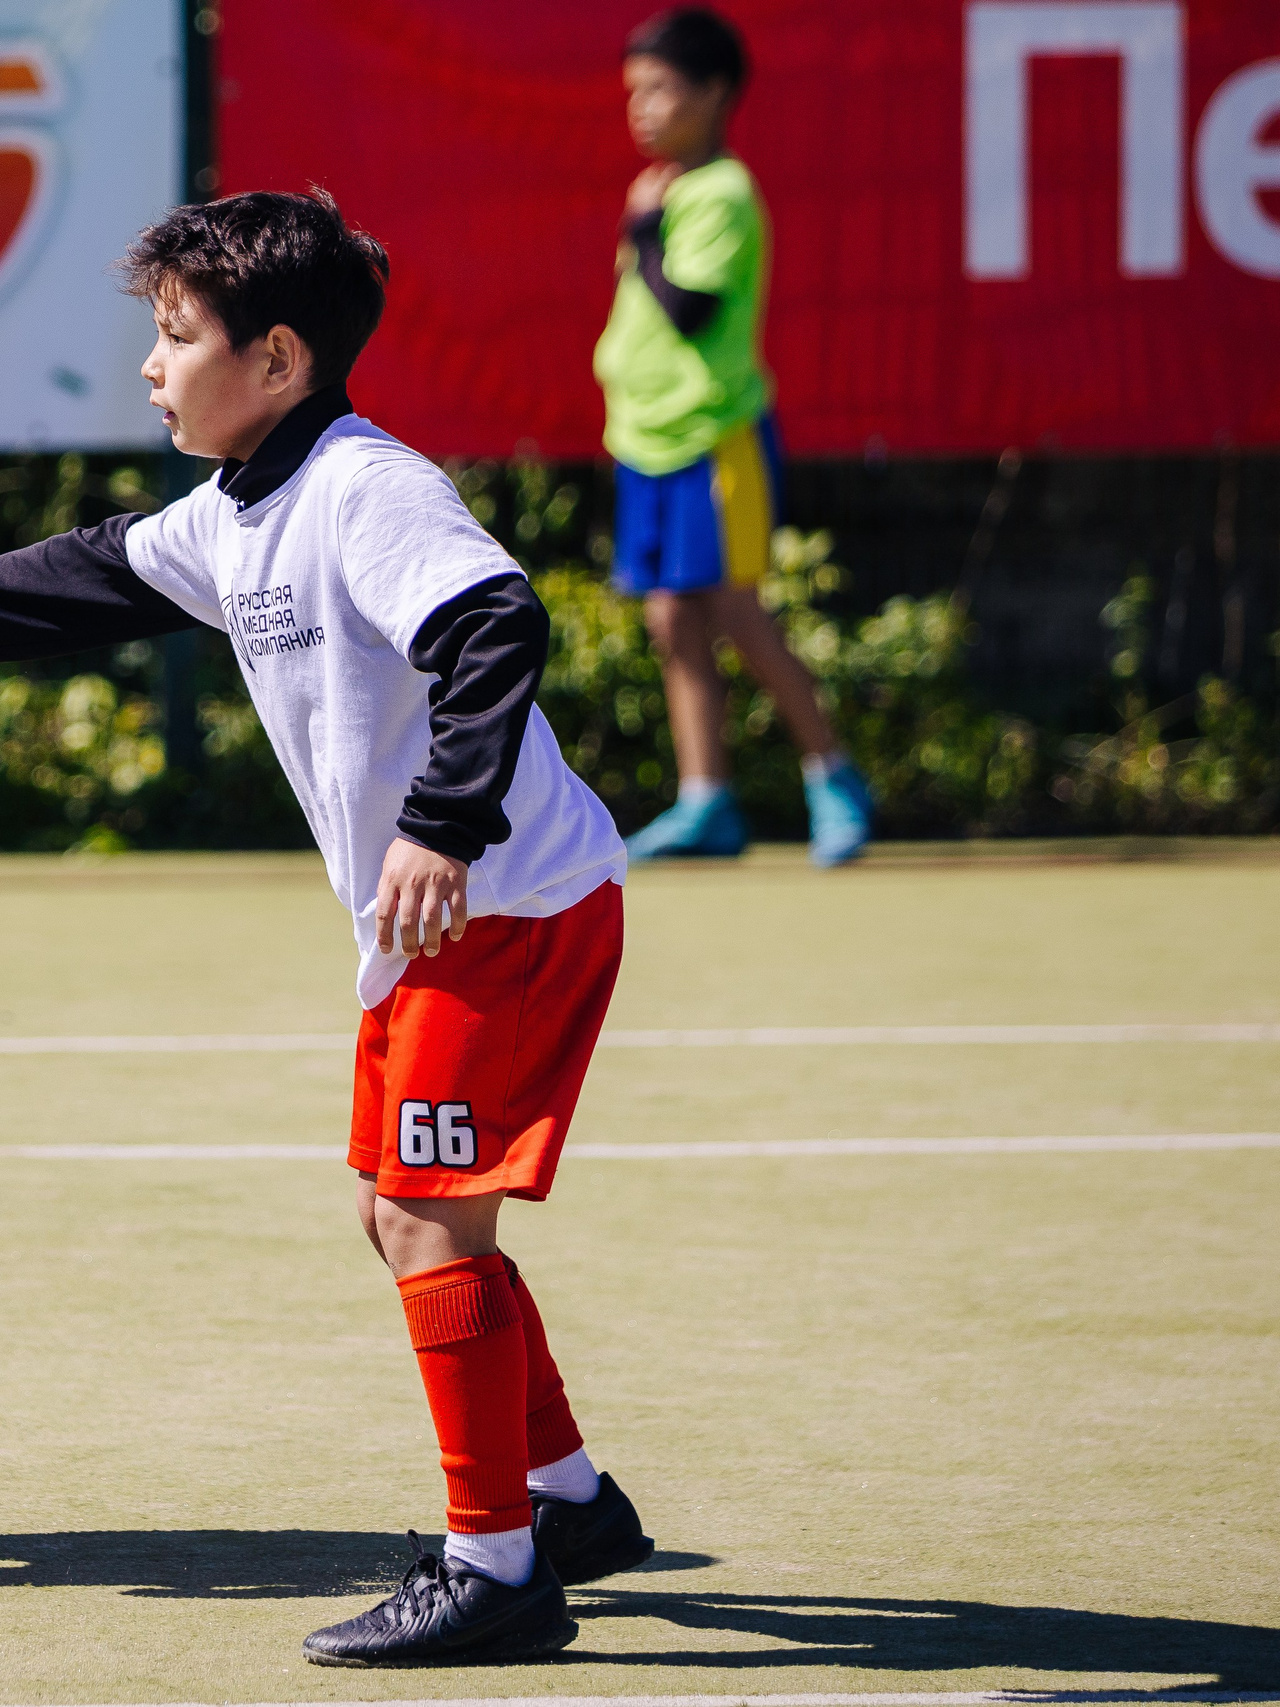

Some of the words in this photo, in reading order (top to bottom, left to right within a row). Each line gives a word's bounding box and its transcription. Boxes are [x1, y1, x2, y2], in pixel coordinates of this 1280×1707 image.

[238, 584, 293, 612] РУССКАЯ
[242, 609, 296, 634] МЕДНАЯ
[248, 627, 325, 657] КОМПАНИЯ
[399, 1098, 478, 1168] 66
